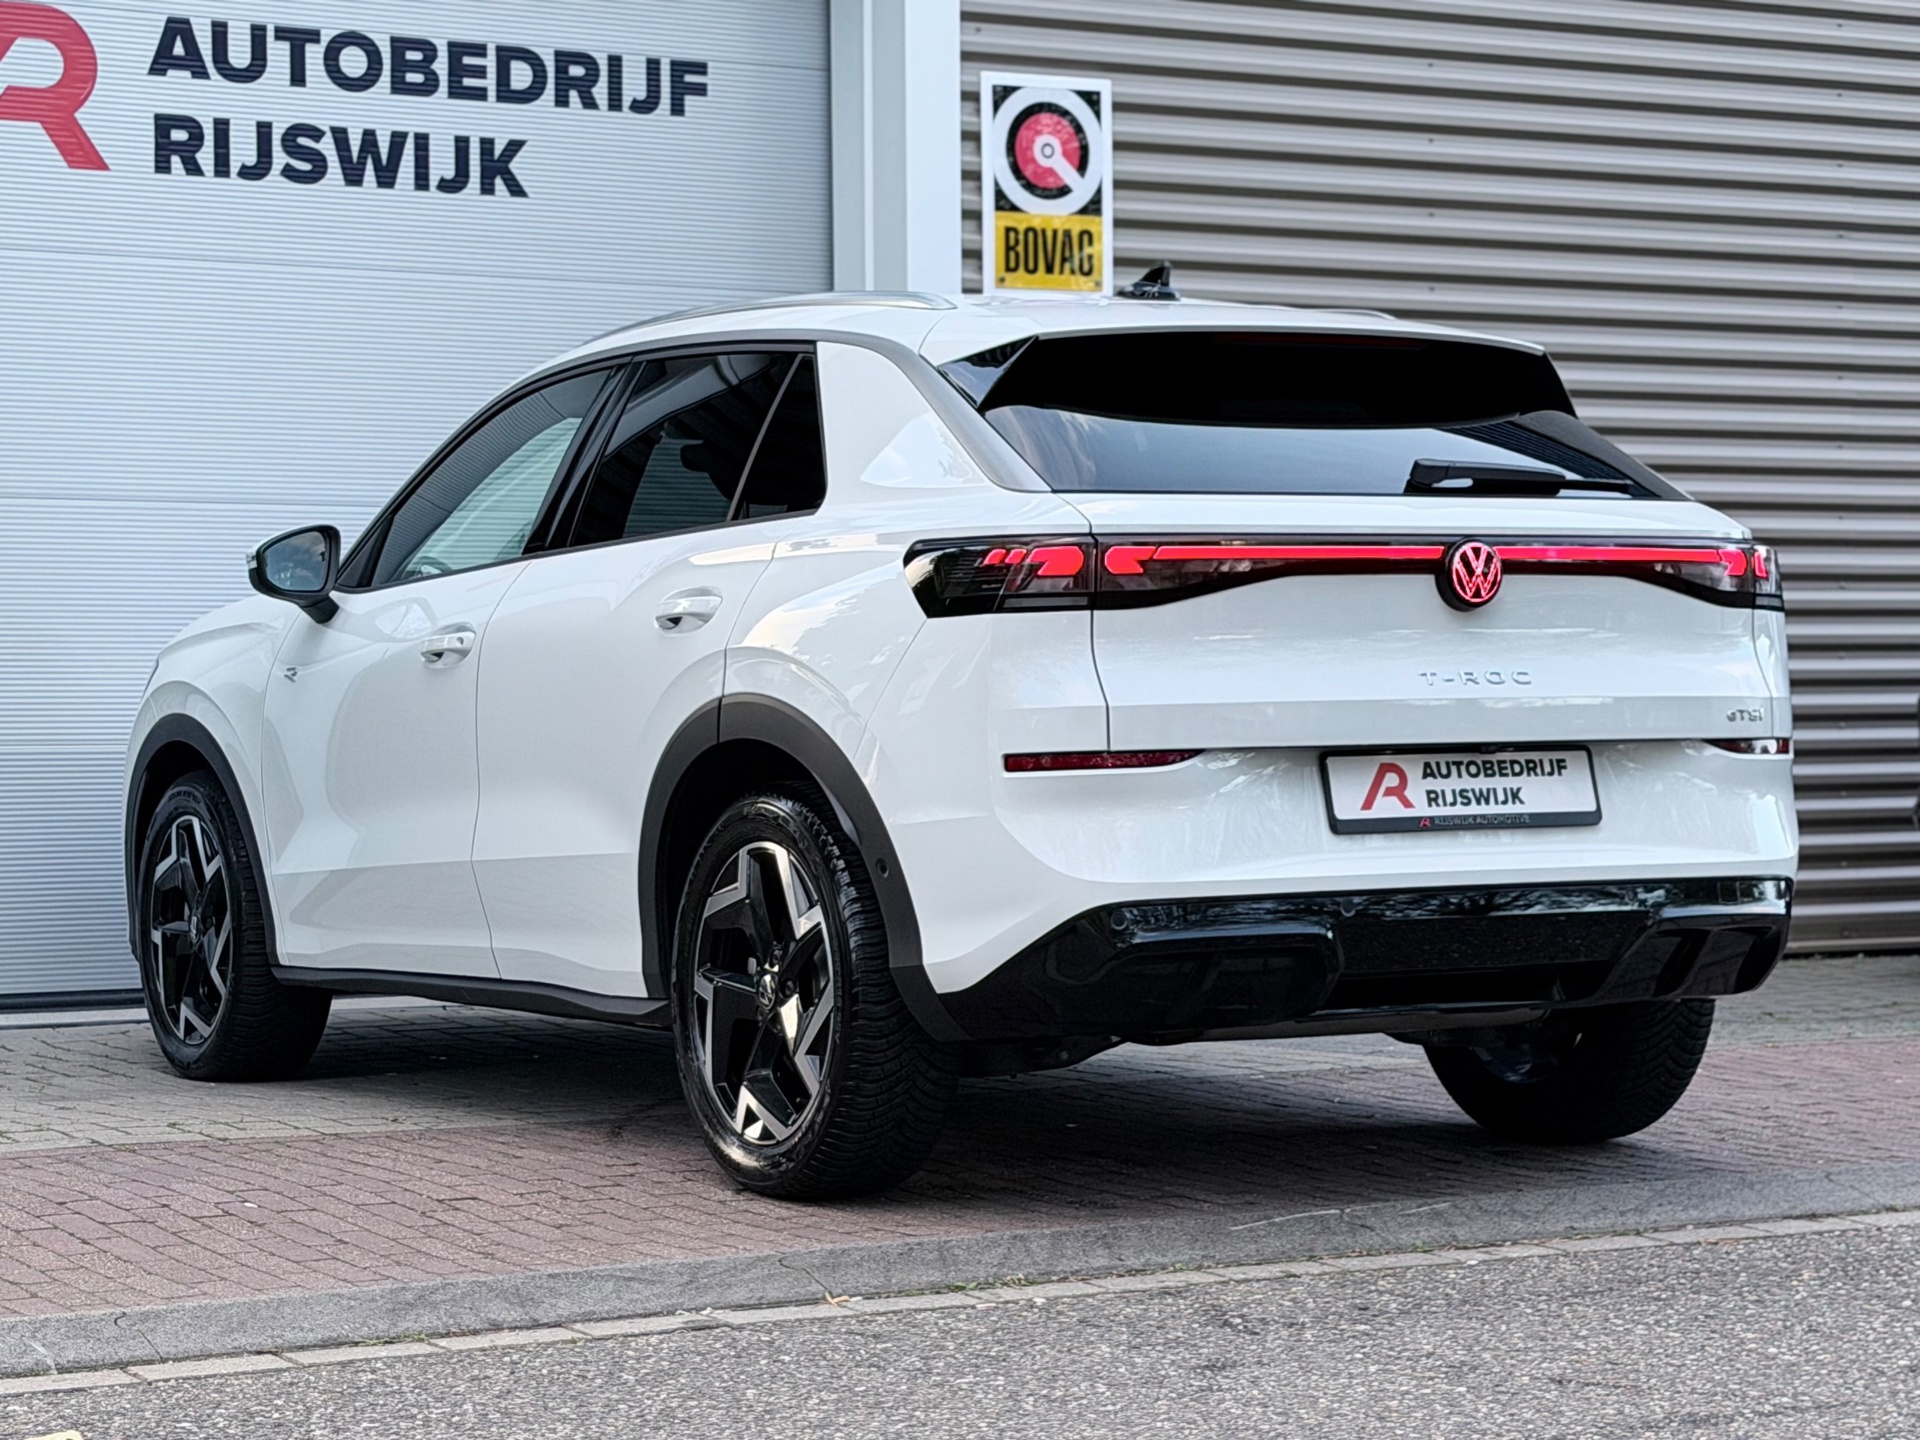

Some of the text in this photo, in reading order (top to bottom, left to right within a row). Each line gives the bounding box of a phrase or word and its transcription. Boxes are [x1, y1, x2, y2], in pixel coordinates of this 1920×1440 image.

[147, 16, 709, 117] AUTOBEDRIJF
[153, 113, 529, 199] RIJSWIJK
[1004, 226, 1094, 277] BOVAG
[1418, 671, 1532, 686] T-ROC
[1421, 758, 1568, 780] AUTOBEDRIJF
[1425, 787, 1526, 808] RIJSWIJK
[1434, 816, 1475, 826] RIJSWIJK
